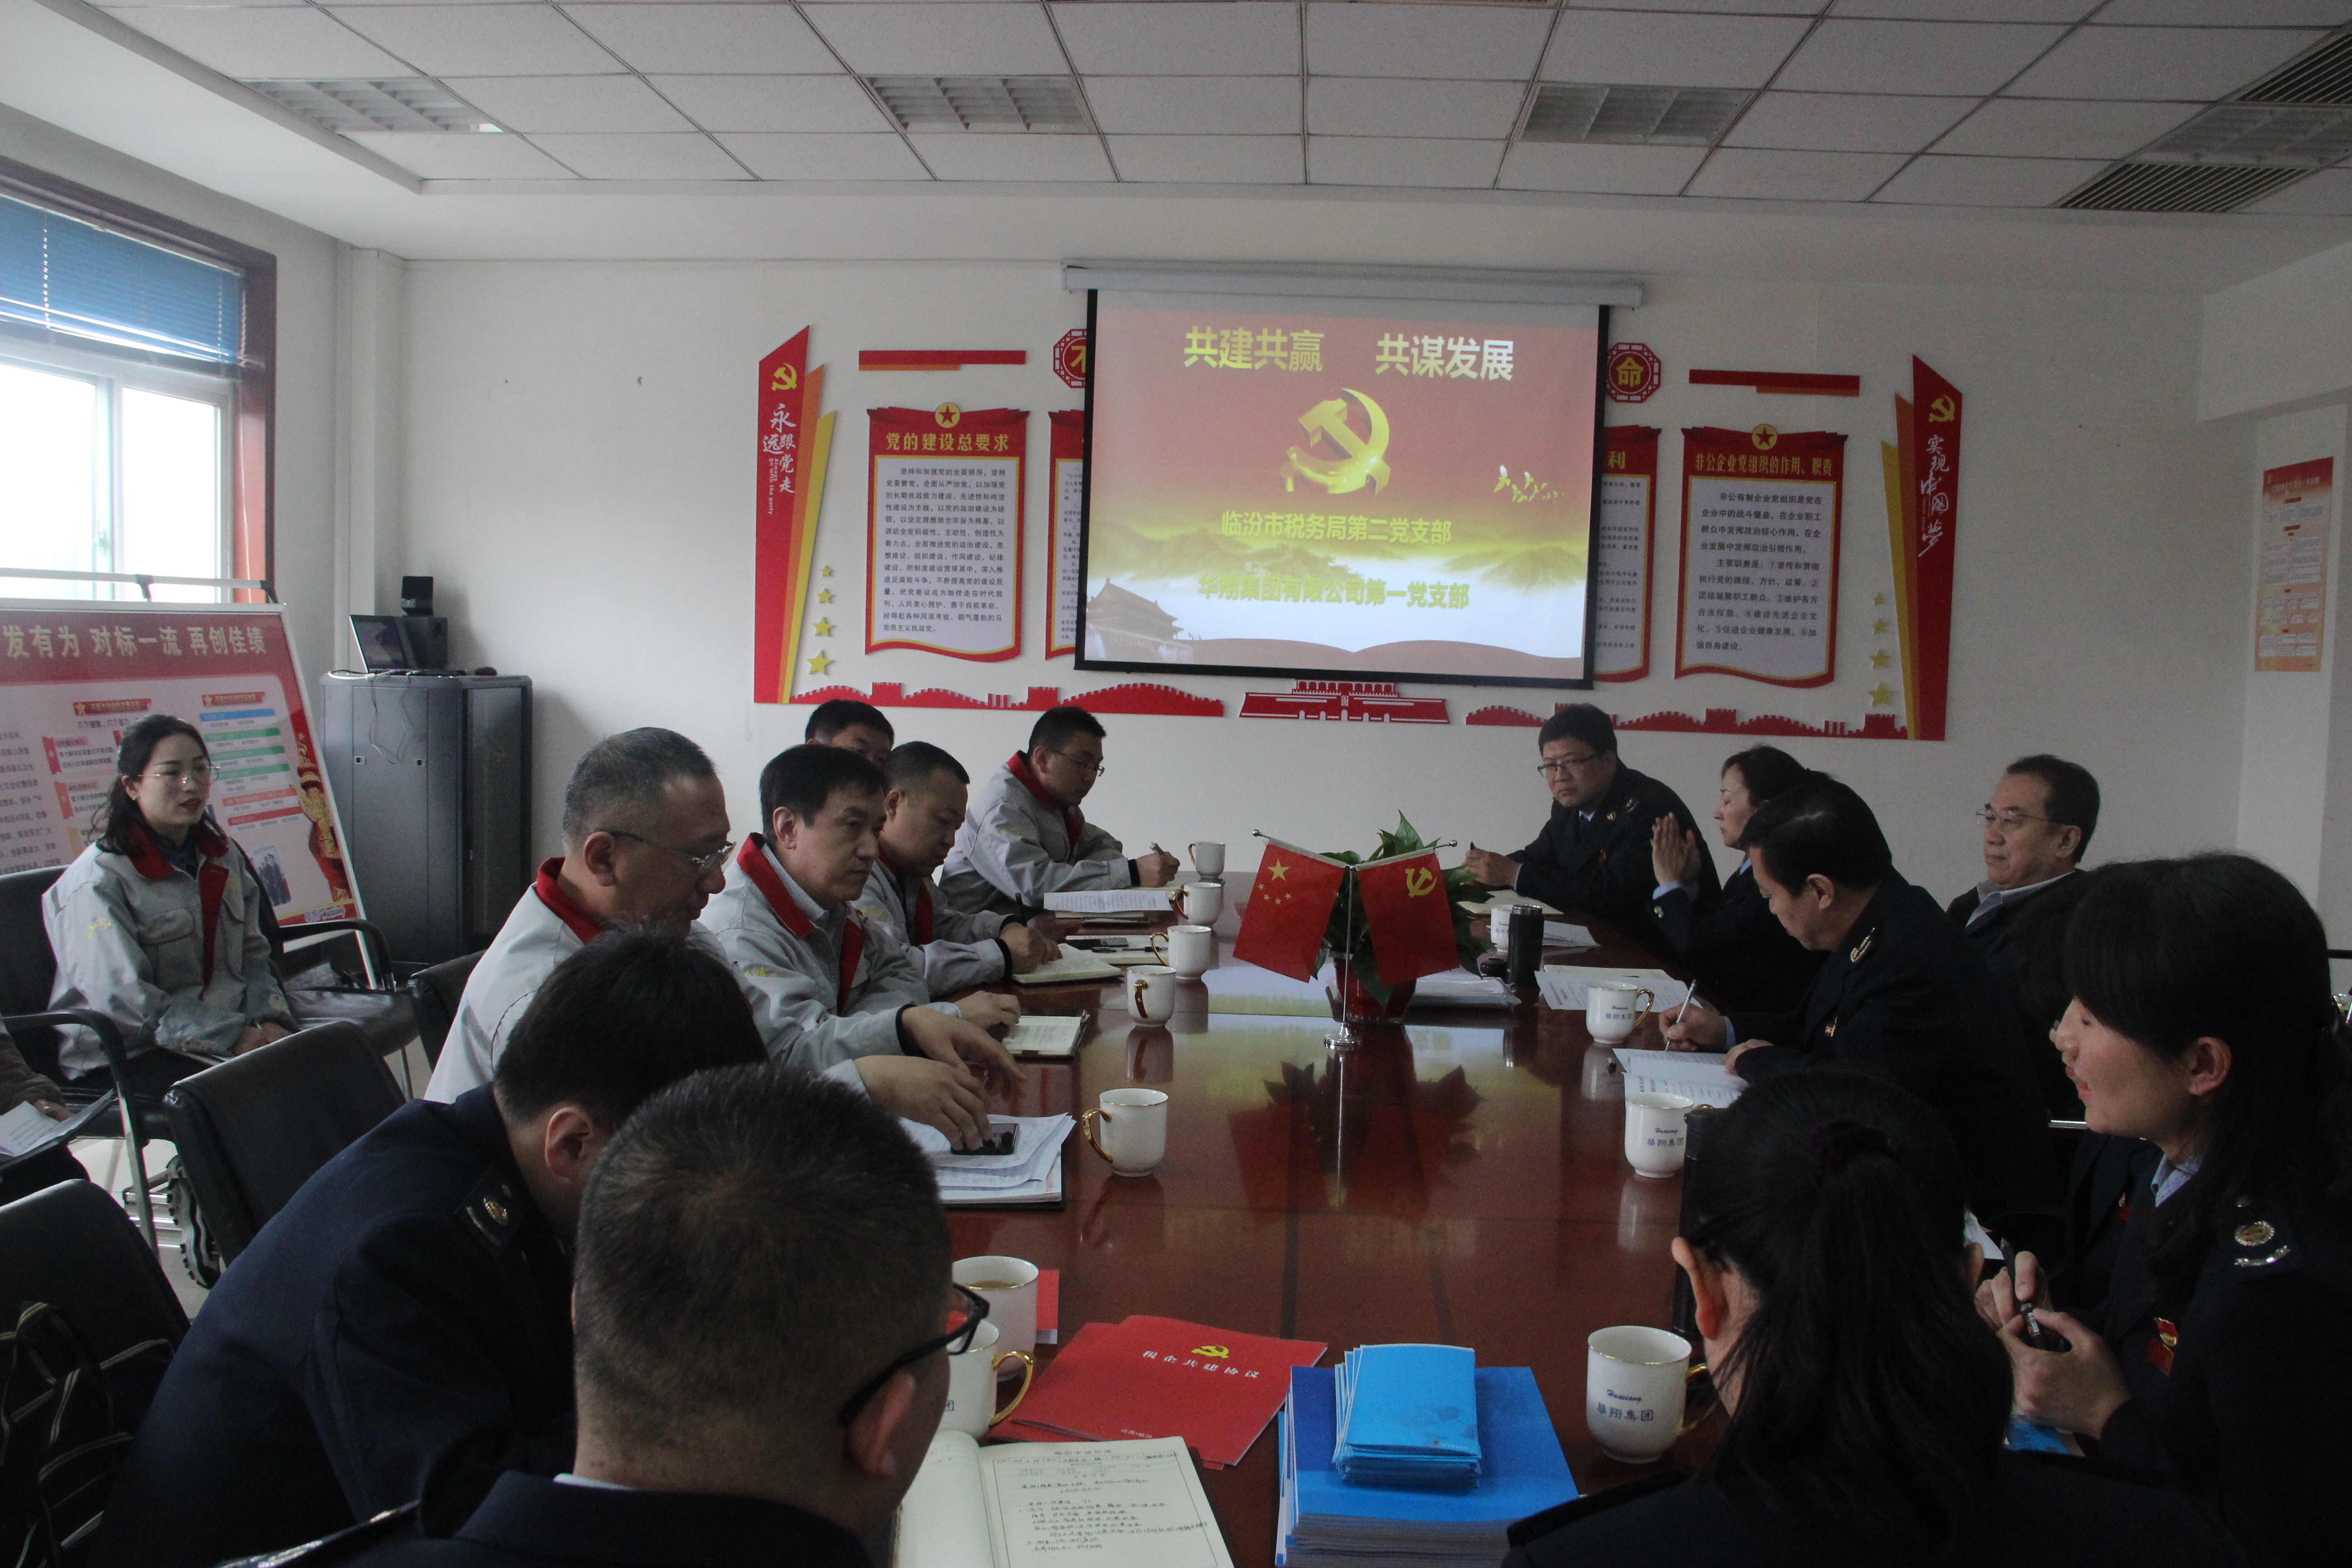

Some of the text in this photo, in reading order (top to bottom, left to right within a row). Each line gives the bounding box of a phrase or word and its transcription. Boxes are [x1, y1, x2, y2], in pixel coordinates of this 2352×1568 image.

[1184, 325, 1514, 381] 共建共赢 共谋发展
[1616, 357, 1644, 387] 命
[886, 433, 1009, 451] 党的建设总要求
[1695, 453, 1832, 476] 非公企业党组织的作用、职责
[1222, 510, 1452, 545] 临汾市税务局第二党支部
[1198, 575, 1470, 609] 华翔集团有限公司第一党支部
[90, 625, 182, 657] 对标一流
[186, 626, 267, 656] 再创佳绩
[1142, 1349, 1260, 1379] 税企共建协议
